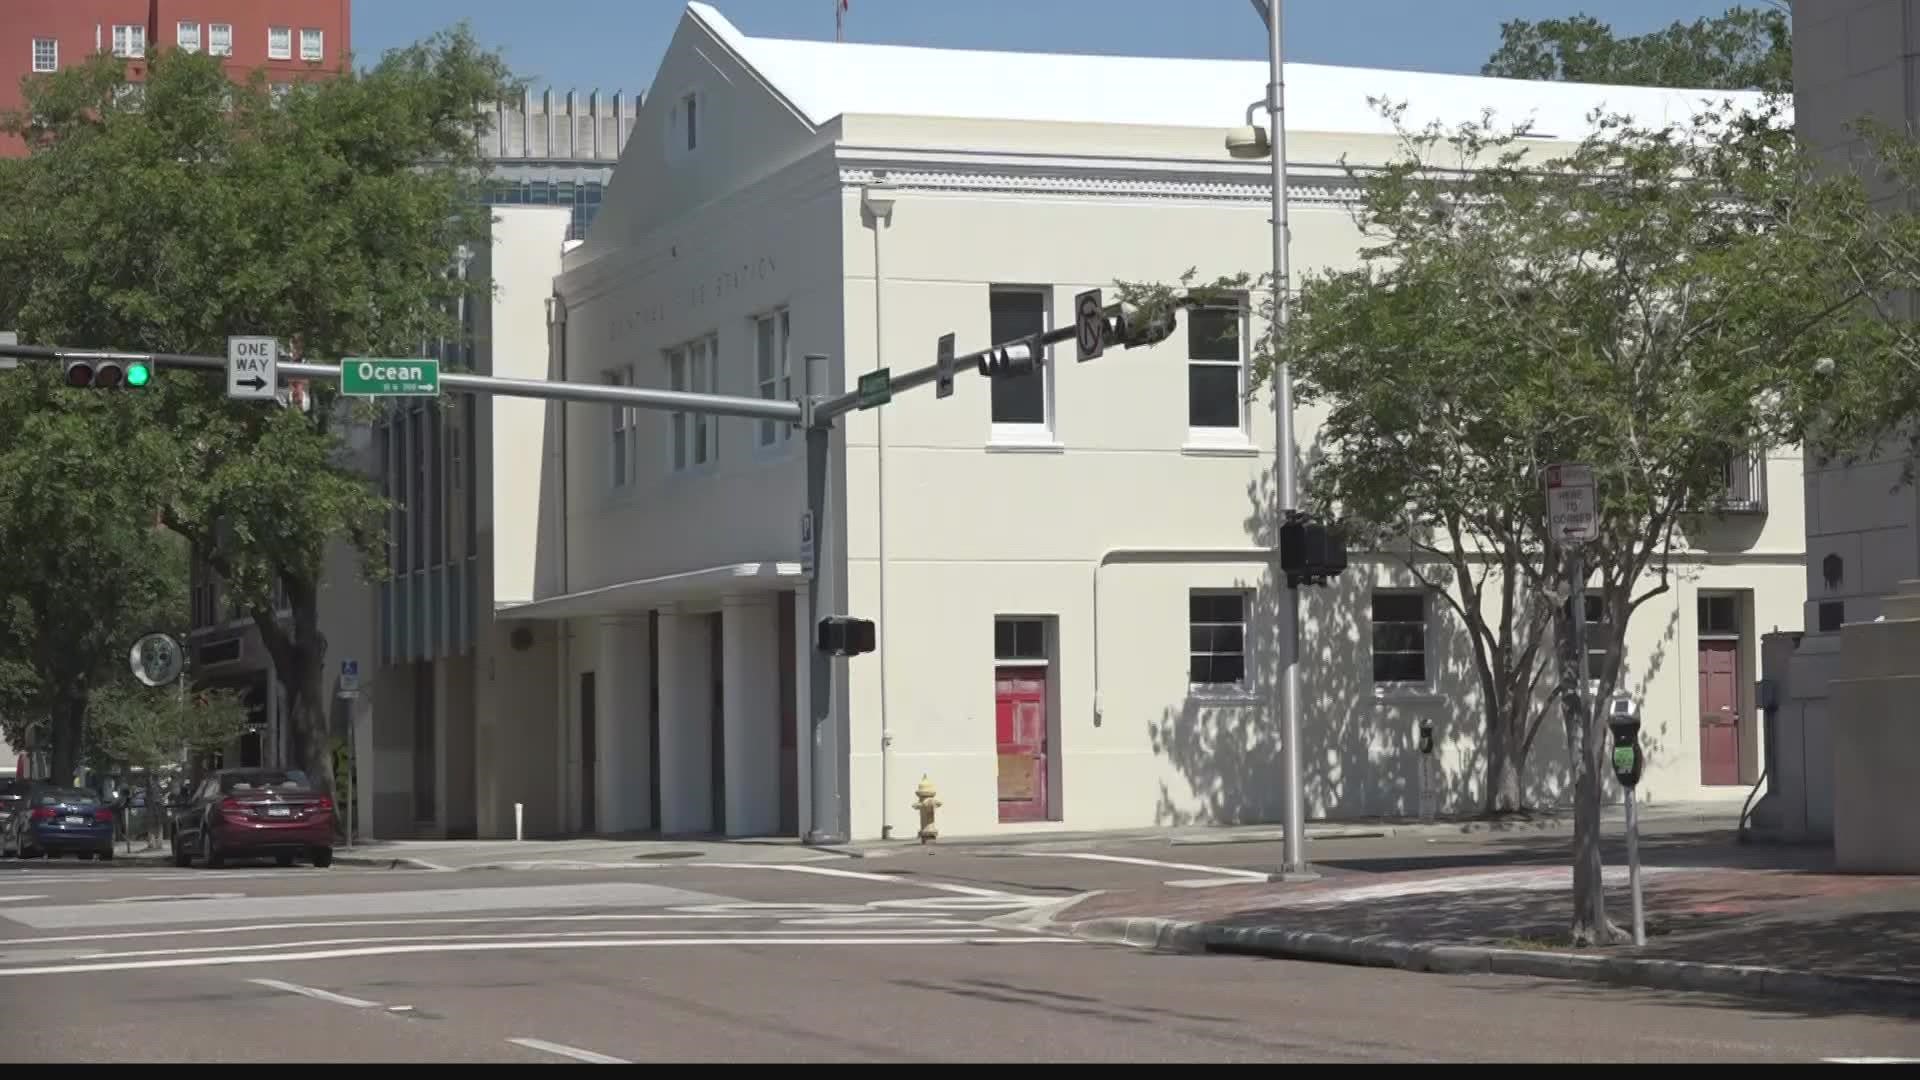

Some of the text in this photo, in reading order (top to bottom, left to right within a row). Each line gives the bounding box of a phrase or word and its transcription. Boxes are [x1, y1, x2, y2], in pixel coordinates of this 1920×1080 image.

[237, 343, 269, 356] ONE
[236, 358, 270, 372] WAY
[358, 362, 422, 381] Ocean
[1567, 502, 1578, 512] TO
[1553, 513, 1592, 524] CORNER
